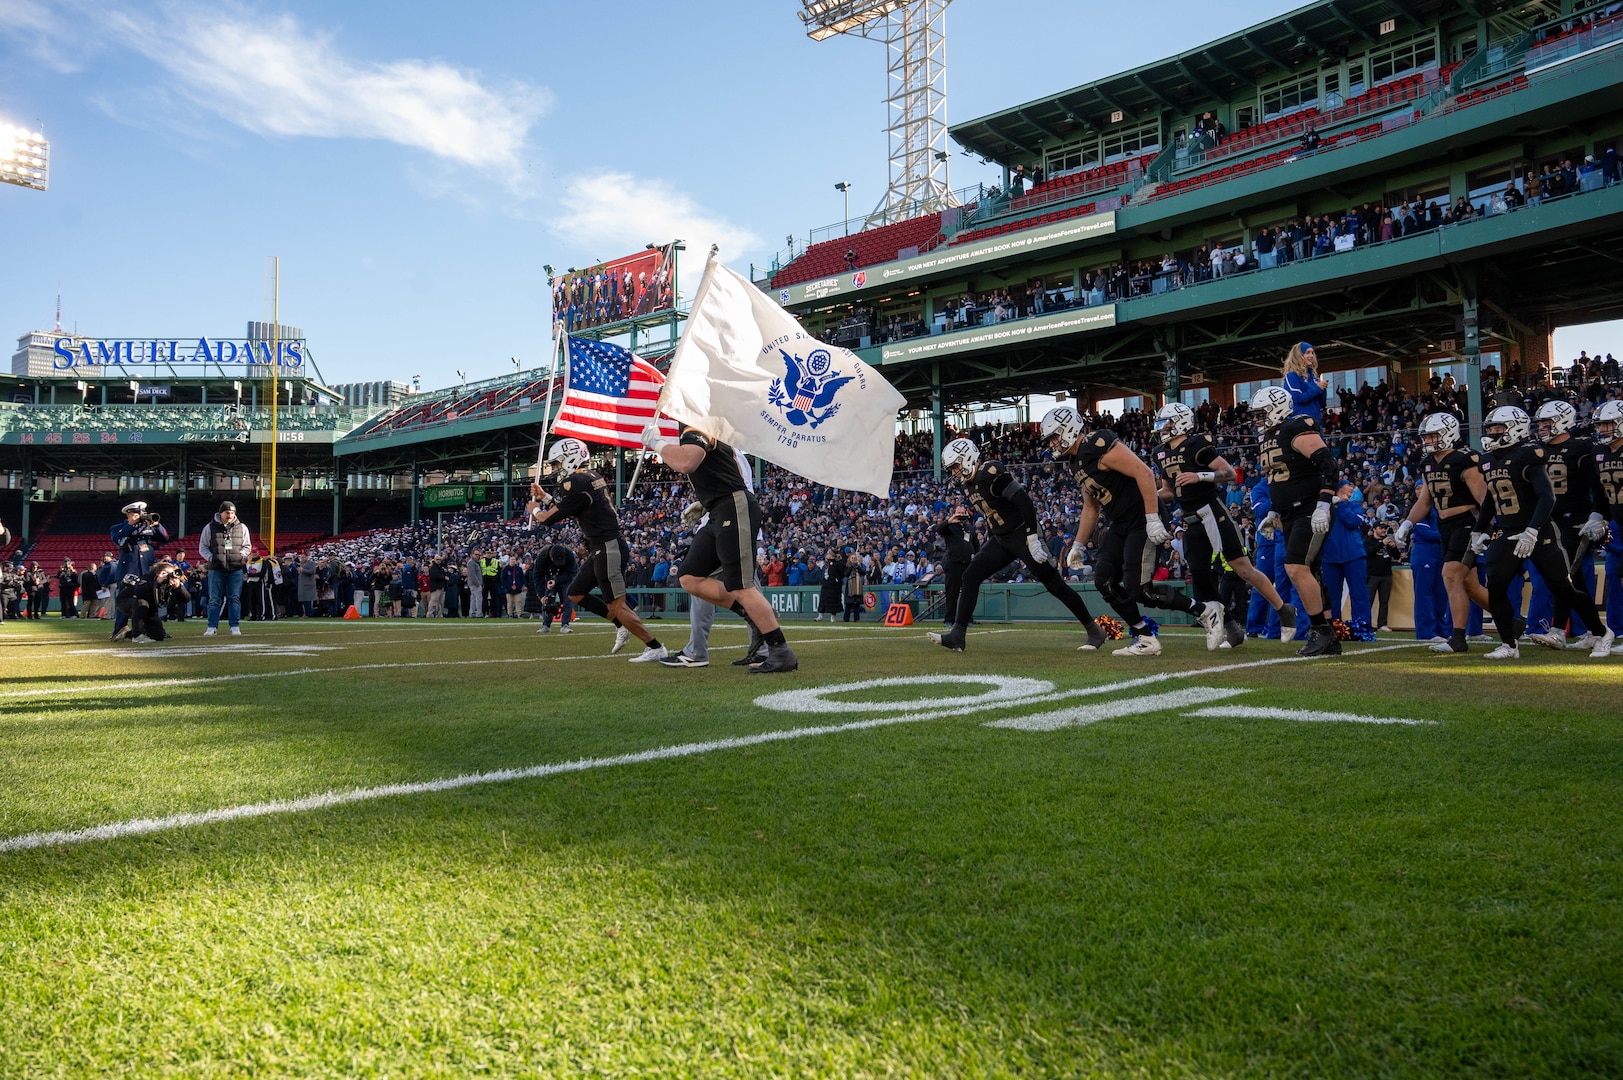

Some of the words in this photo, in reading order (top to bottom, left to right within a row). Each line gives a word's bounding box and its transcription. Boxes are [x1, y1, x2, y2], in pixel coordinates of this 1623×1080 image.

[908, 262, 922, 271] YOUR
[923, 260, 937, 269] NEXT
[937, 252, 969, 265] ADVENTURE
[994, 242, 1011, 251] BOOK
[1011, 238, 1026, 248] NOW
[1033, 219, 1115, 243] AmericanForcesTravel.com
[816, 287, 829, 299] CUP
[762, 334, 789, 354] UNITED
[908, 346, 922, 354] YOUR
[923, 343, 937, 351] NEXT
[937, 337, 969, 349] ADVENTURE
[994, 329, 1011, 339] BOOK
[1011, 327, 1026, 335] NOW
[1033, 312, 1115, 332] AmericanForcesTravel.com
[53, 336, 186, 370] SAMUEL
[190, 335, 304, 368] ADAMS
[853, 362, 867, 390] GUARD
[20, 432, 34, 444] 14
[45, 432, 62, 444] 45
[72, 432, 91, 444] 26
[101, 431, 118, 443] 34
[129, 431, 143, 443] 42
[279, 432, 304, 441] 11:58
[760, 410, 787, 434] SEMPER
[791, 431, 827, 443] PARATUS
[777, 434, 798, 449] 1790
[438, 487, 464, 498] HORNITOS
[1428, 481, 1453, 510] 17
[1487, 479, 1520, 516] 19
[887, 606, 906, 624] 20
